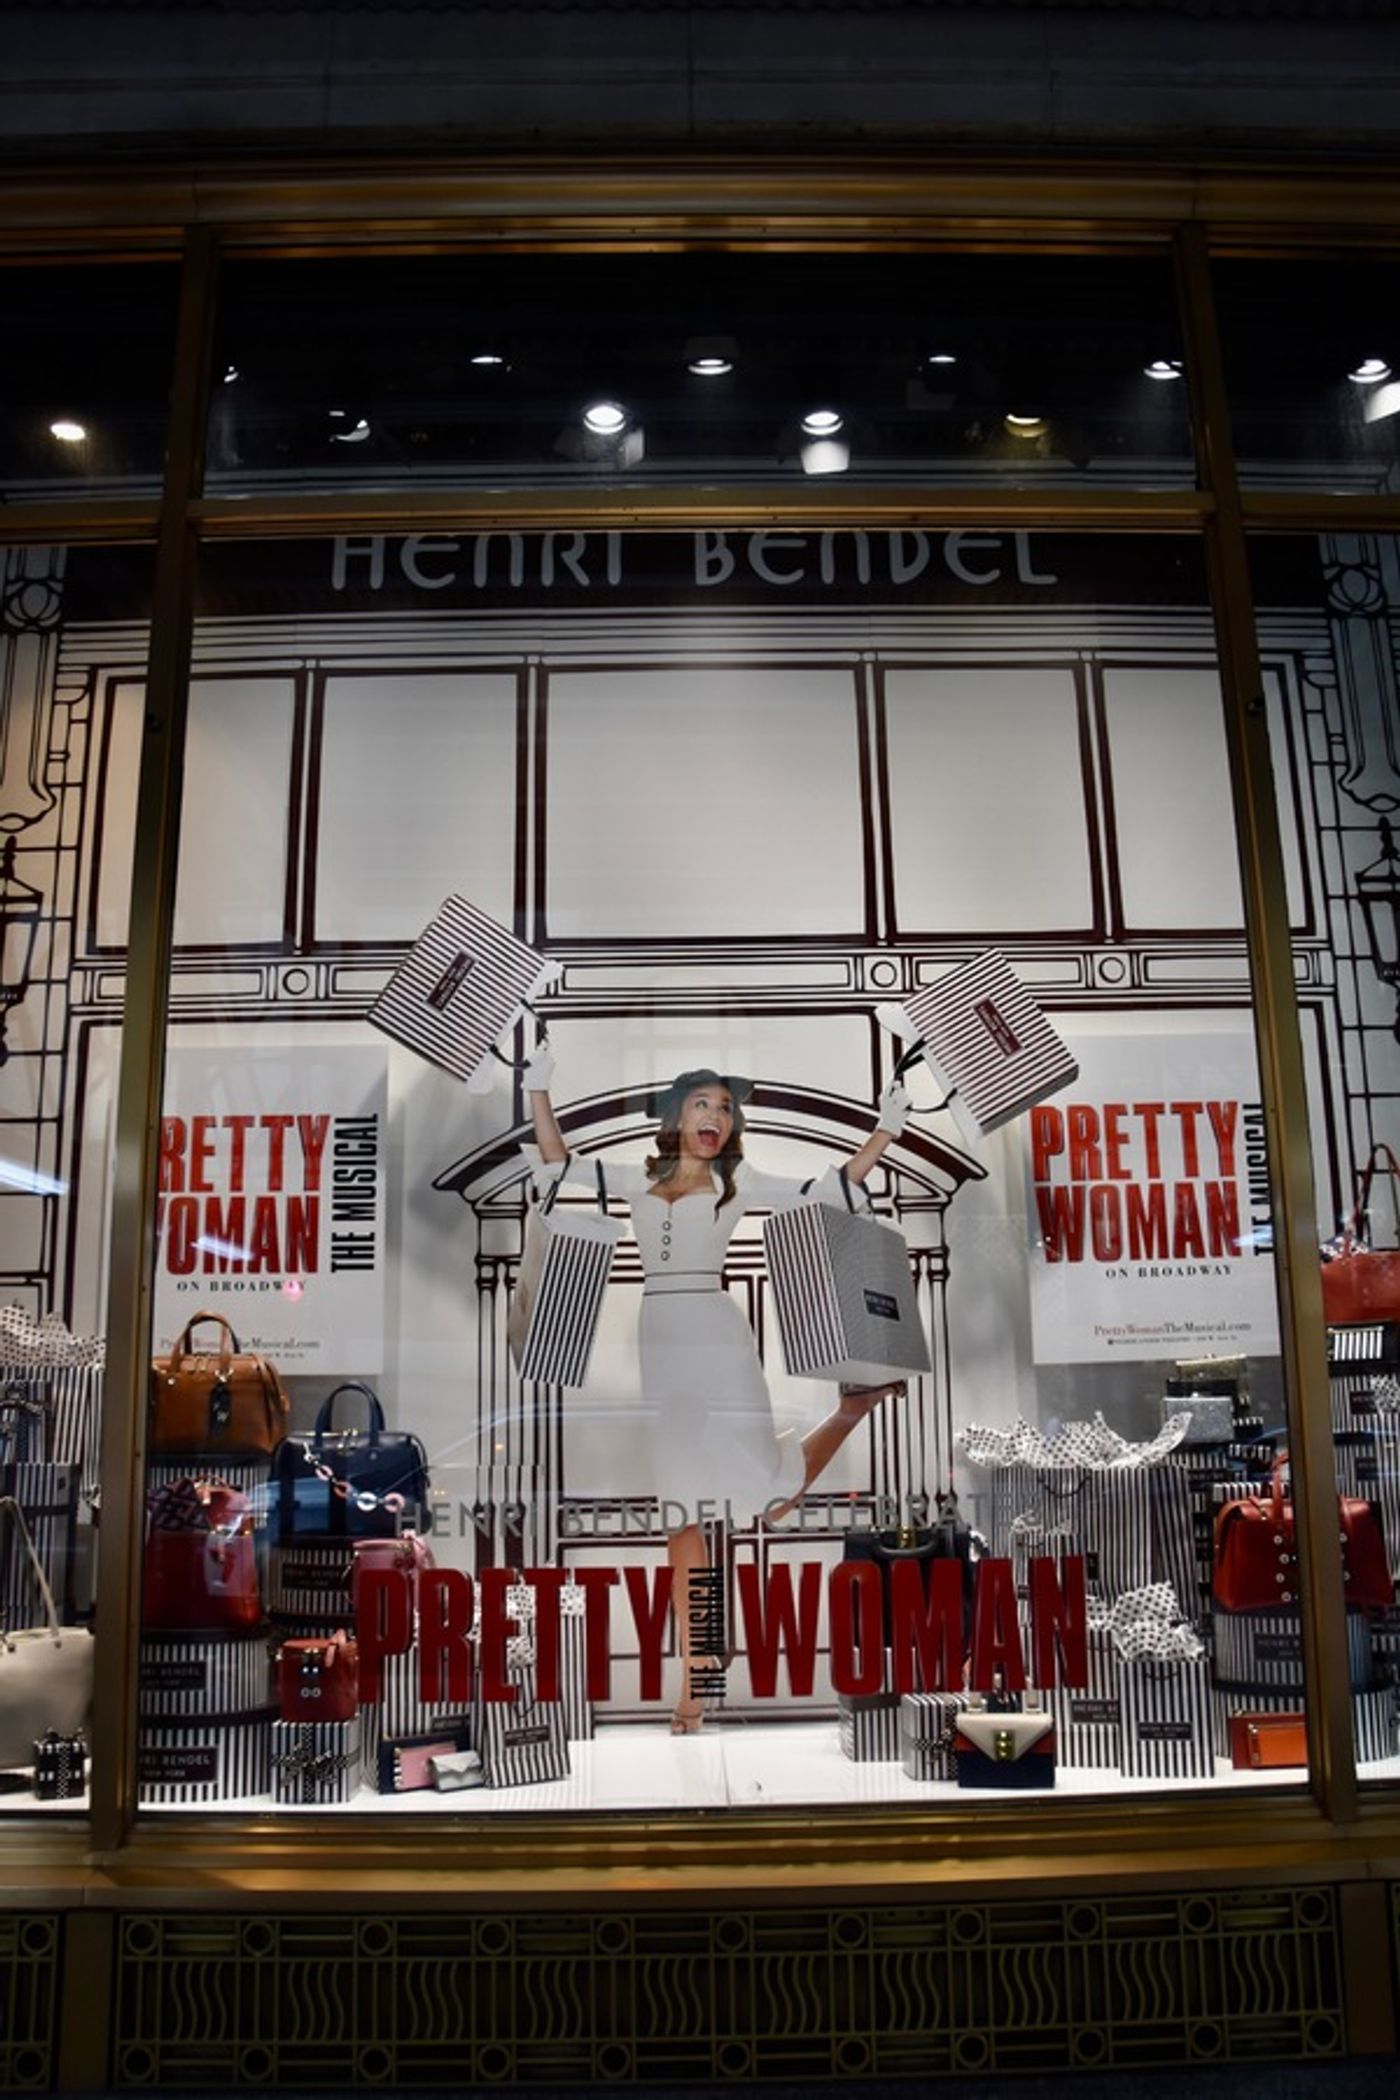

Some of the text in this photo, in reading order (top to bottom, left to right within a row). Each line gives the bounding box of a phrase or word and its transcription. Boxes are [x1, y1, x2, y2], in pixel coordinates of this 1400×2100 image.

[159, 1115, 331, 1192] RETTY
[1031, 1101, 1239, 1182] PRETTY
[331, 1114, 379, 1273] THE MUSICAL
[1035, 1181, 1242, 1263] WOMAN
[177, 1280, 200, 1292] ON
[1105, 1265, 1233, 1279] ON BROADWAY
[395, 1500, 537, 1538] HENRI
[561, 1498, 743, 1537] BENDEL
[355, 1567, 675, 1701] PRETTY
[688, 1566, 726, 1700] THE MUSICAL
[737, 1557, 1088, 1697] WOMAN
